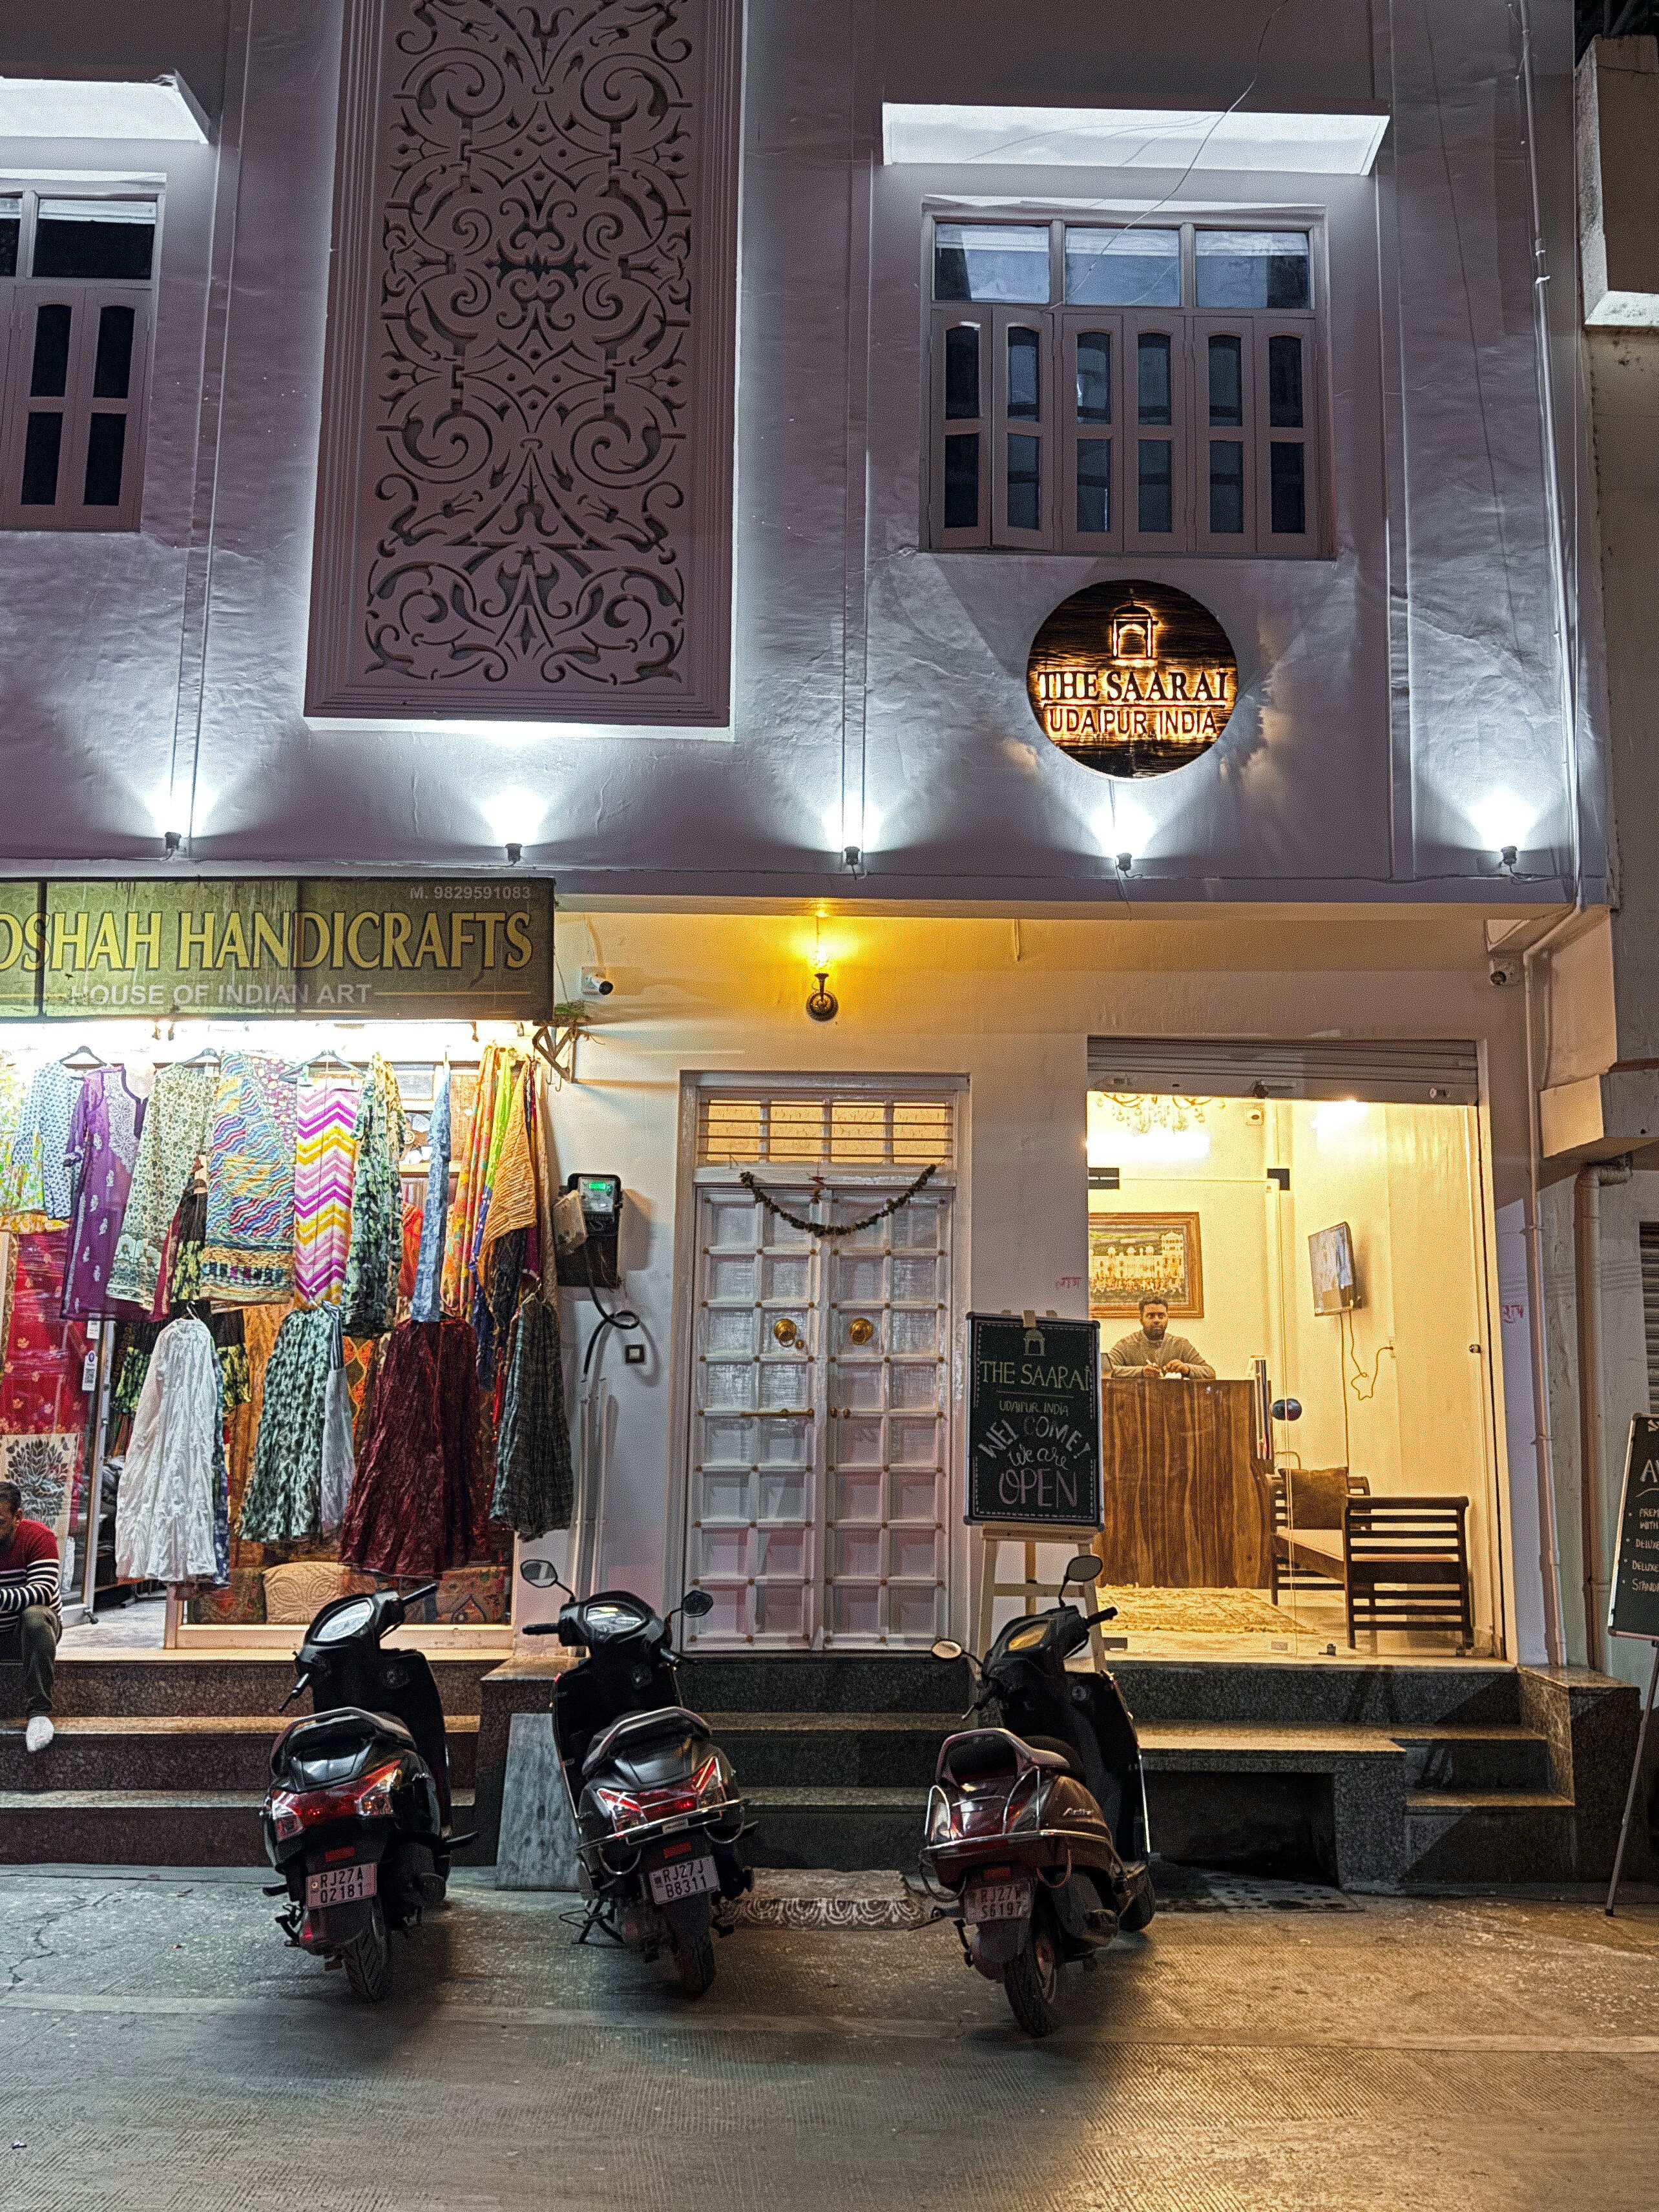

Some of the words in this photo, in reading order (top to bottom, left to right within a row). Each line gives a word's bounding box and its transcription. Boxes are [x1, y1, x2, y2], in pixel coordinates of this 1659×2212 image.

[1038, 671, 1098, 702] THE
[1106, 671, 1229, 702] SAARAI
[1049, 708, 1147, 735] UDAIPUR
[1160, 709, 1217, 735] INDIA
[410, 886, 428, 899] M.
[433, 886, 532, 900] 9829591083
[178, 910, 533, 970] HANDICRAFTS
[69, 984, 165, 1006] HOUSE
[172, 984, 210, 1005] OF
[218, 984, 308, 1005] INDIAN
[316, 983, 372, 1005] ART
[979, 1361, 1016, 1384] THE
[1020, 1364, 1090, 1391] SAARAI
[1037, 1447, 1069, 1471] are
[998, 1468, 1078, 1508] OPEN
[320, 1866, 363, 1888] RJ27A
[662, 1859, 704, 1883] RJ27J
